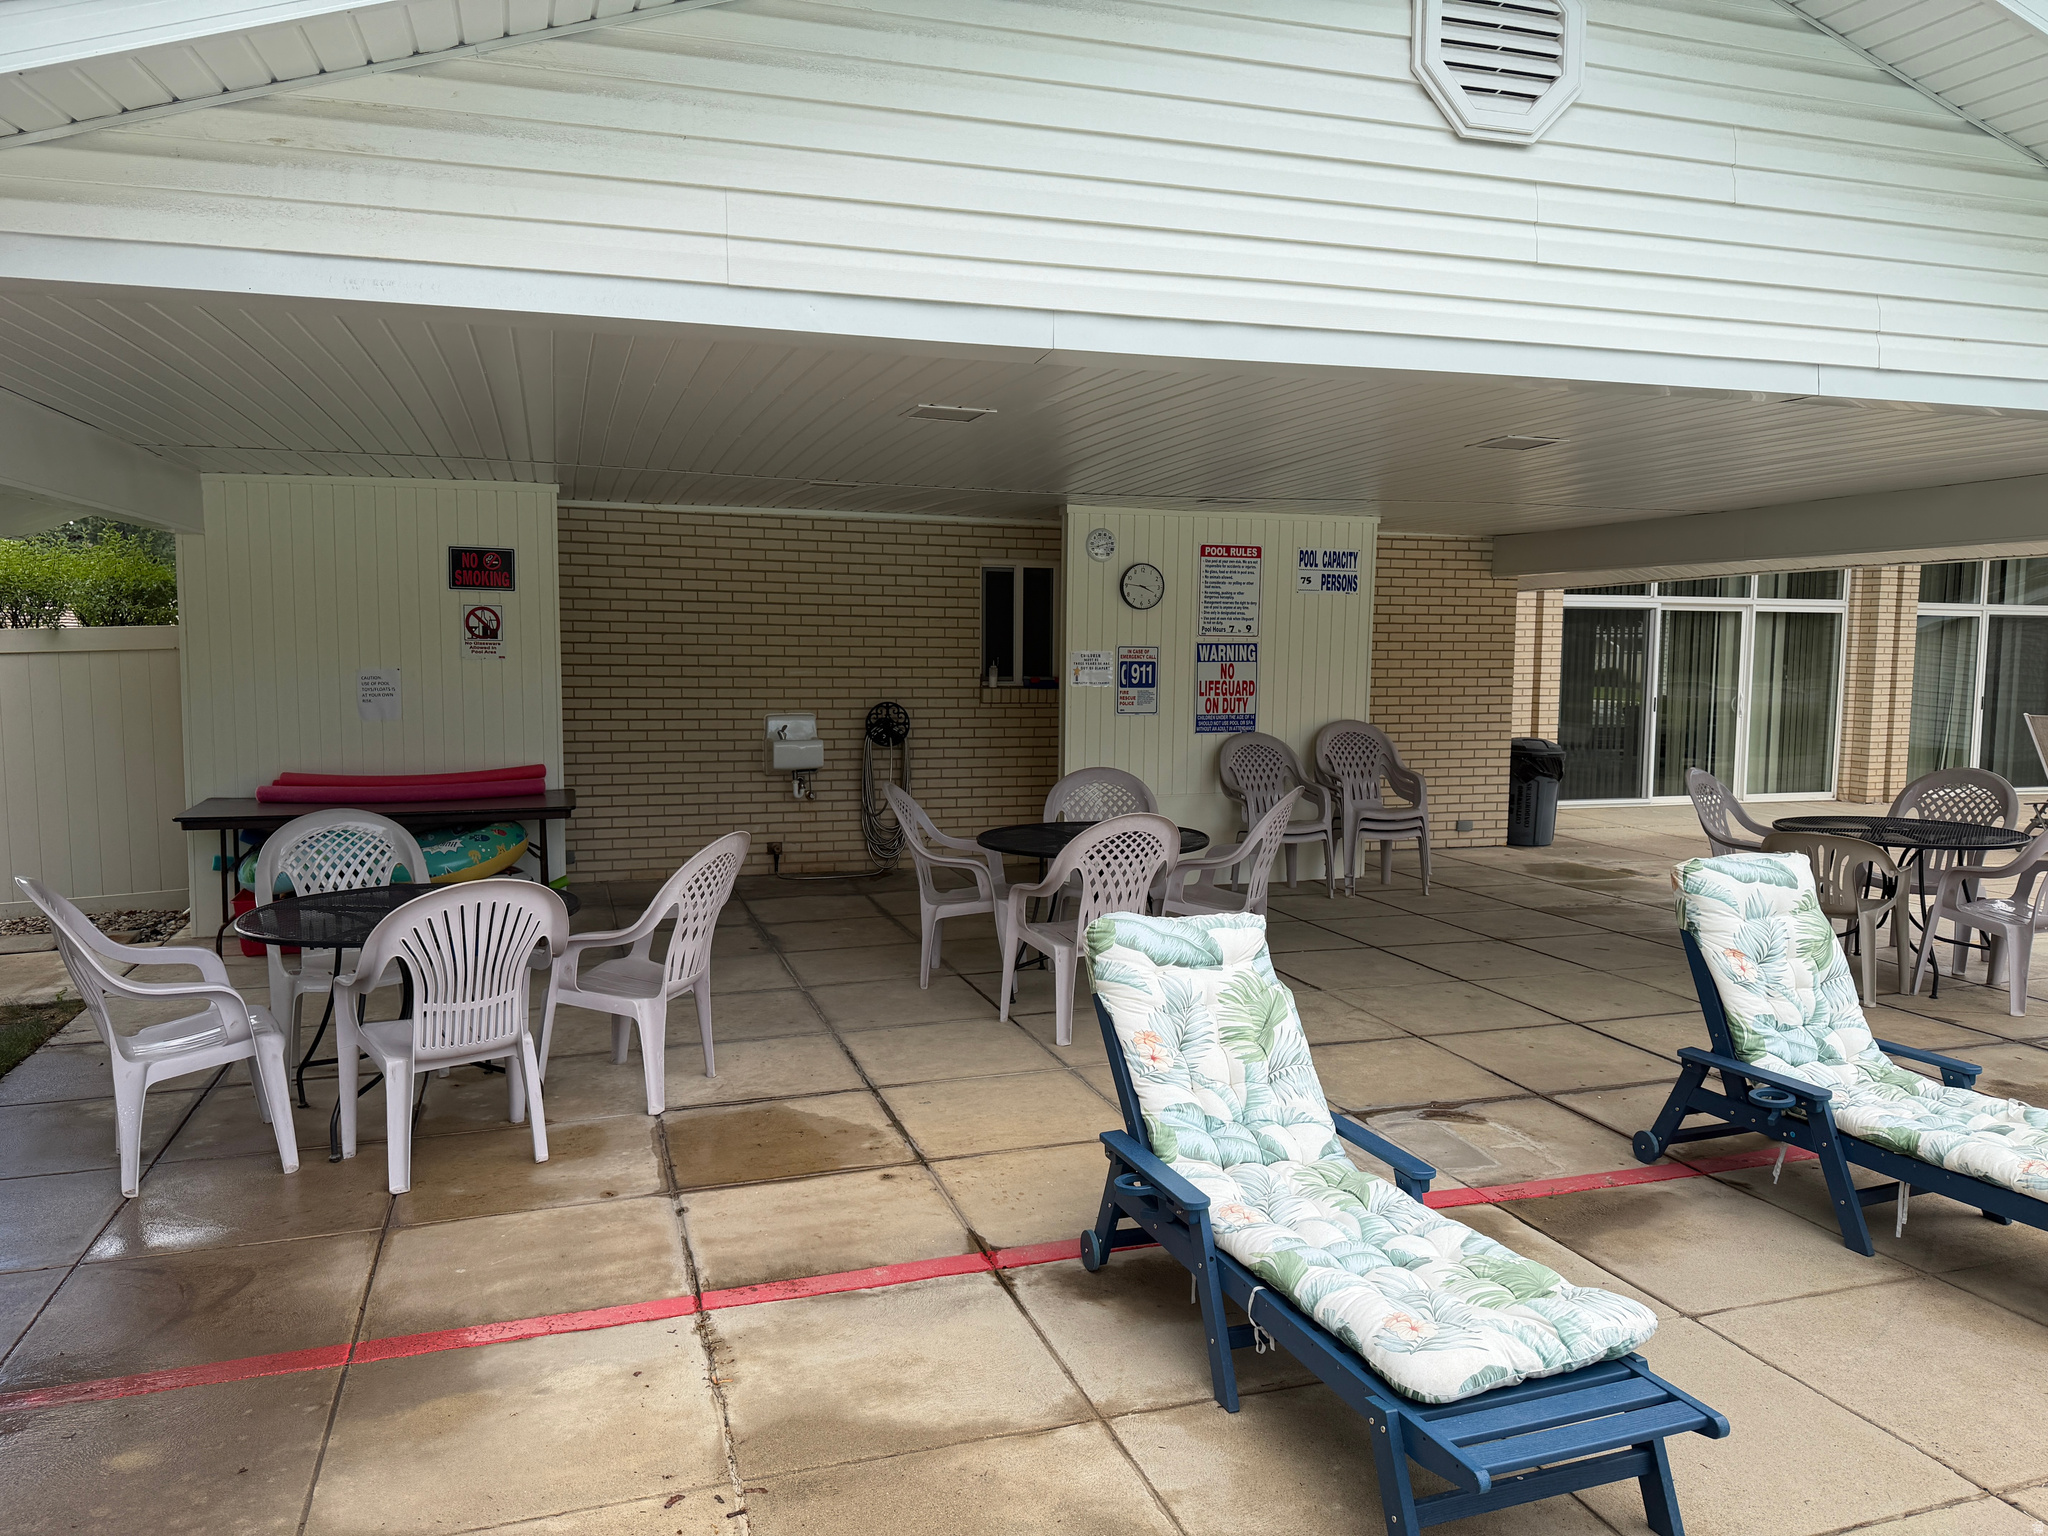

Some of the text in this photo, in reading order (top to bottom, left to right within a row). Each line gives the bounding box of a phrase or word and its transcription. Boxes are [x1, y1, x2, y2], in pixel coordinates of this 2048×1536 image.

[462, 552, 478, 568] NO
[1205, 547, 1257, 557] POOL RULES
[1299, 550, 1358, 569] POOL CAPACITY
[455, 570, 510, 587] SMOKING
[1321, 574, 1358, 592] PERSONS
[1199, 645, 1256, 661] WARNING
[1131, 664, 1152, 684] 911
[1221, 663, 1234, 679] NO
[1199, 680, 1255, 696] LIFEGUARD
[1205, 697, 1248, 714] ON DUTY
